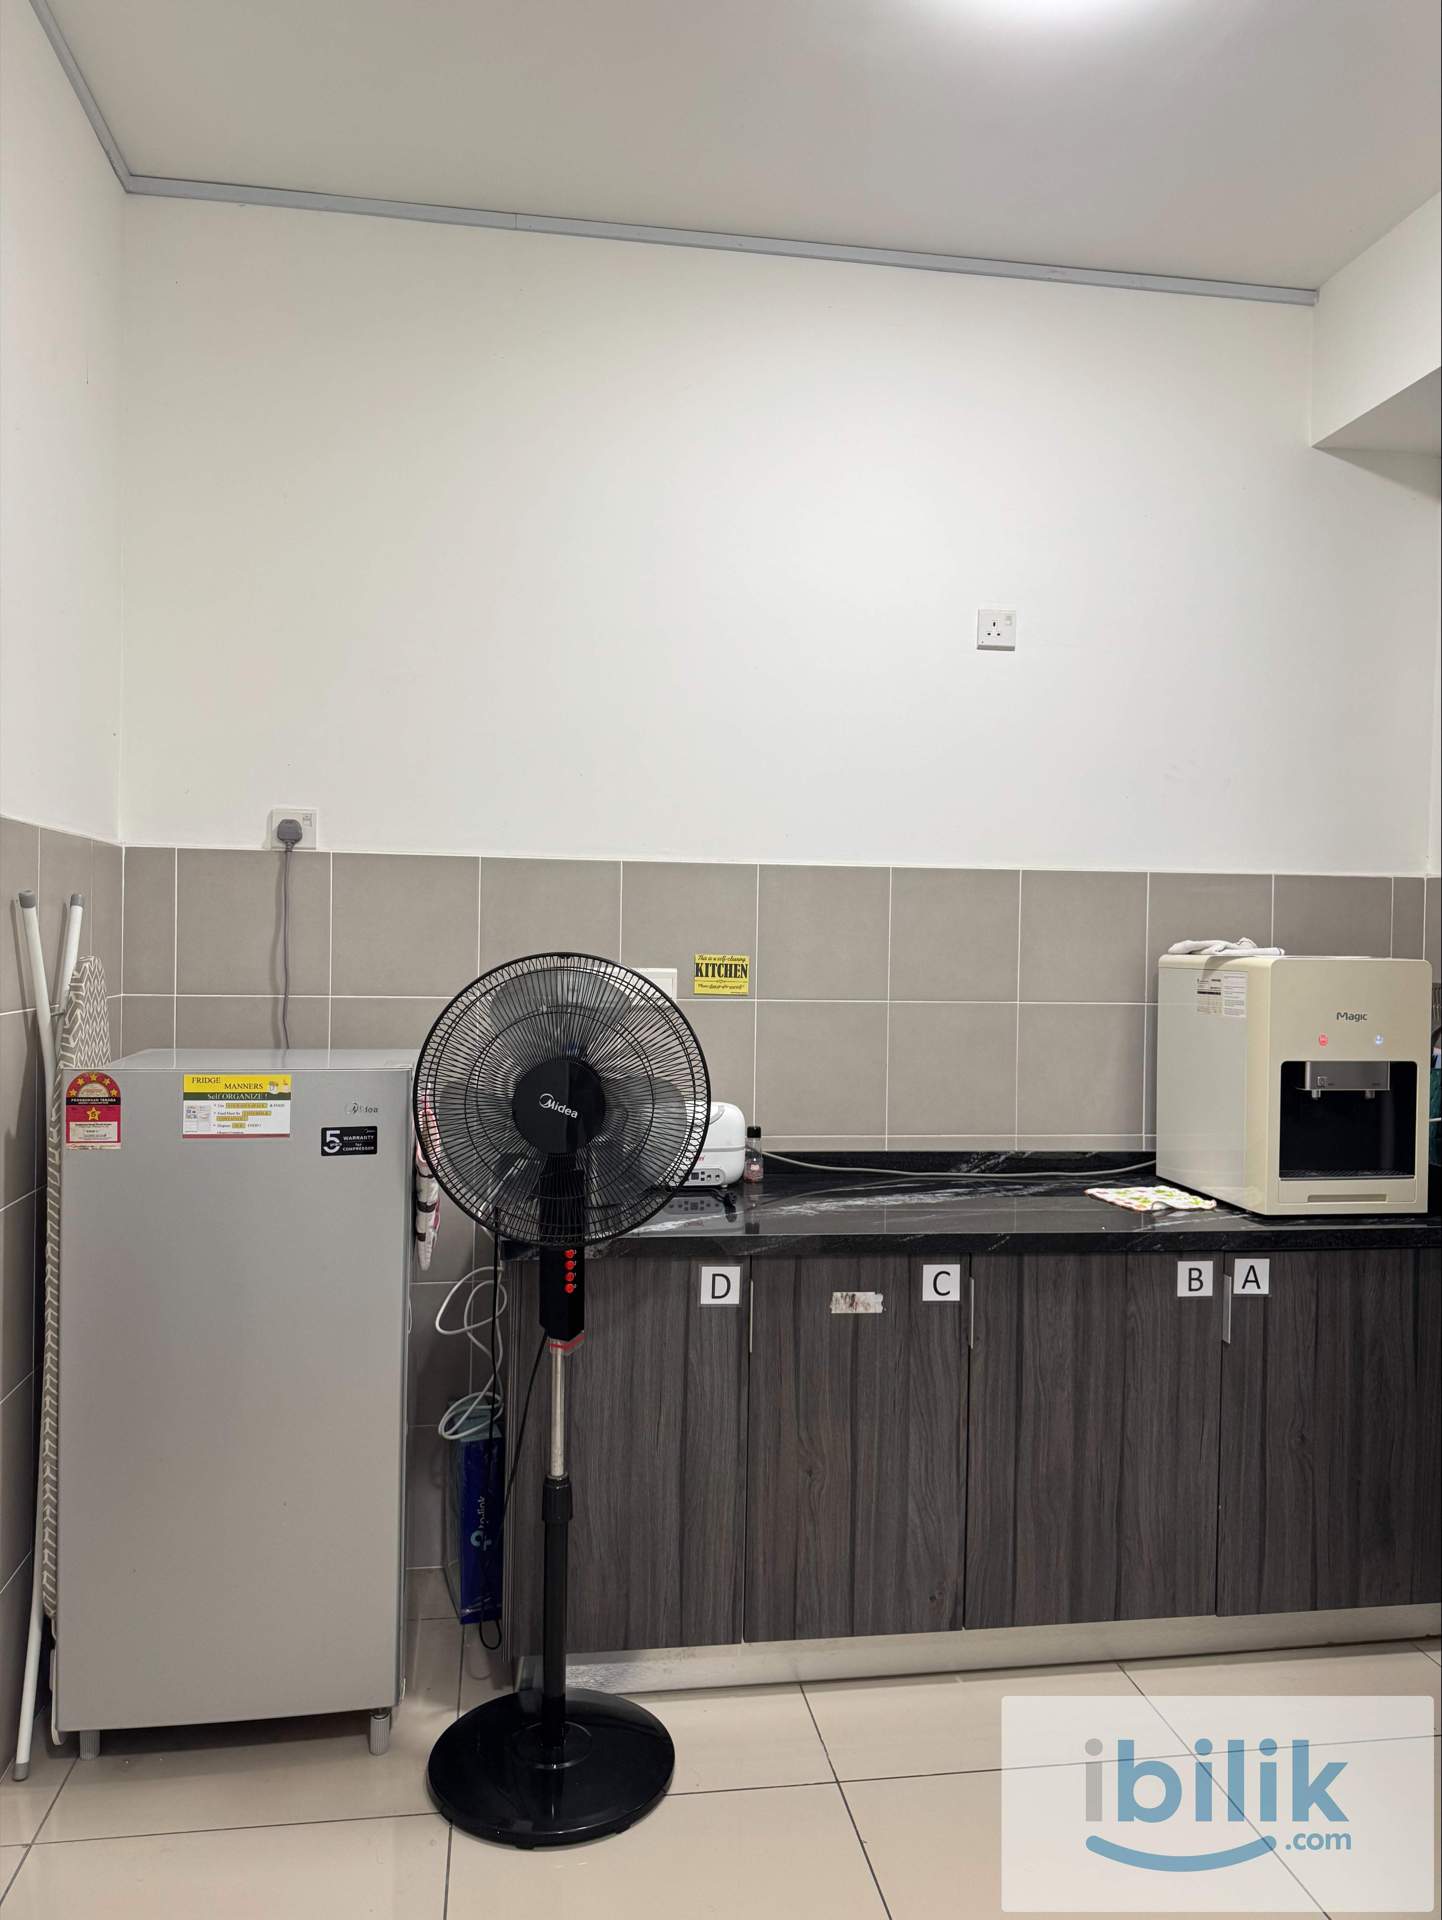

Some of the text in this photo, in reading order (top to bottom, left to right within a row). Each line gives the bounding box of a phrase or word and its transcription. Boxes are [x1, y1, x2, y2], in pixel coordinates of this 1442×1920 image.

[695, 962, 748, 979] KITCHEN
[1336, 1011, 1368, 1023] Magic
[191, 1076, 221, 1084] FRIDGE
[224, 1082, 264, 1090] MANNERS
[540, 1095, 578, 1118] Midea
[323, 1130, 341, 1153] 5
[711, 1273, 731, 1300] D
[932, 1270, 951, 1297] C
[1188, 1267, 1204, 1292] B
[1242, 1265, 1260, 1289] A
